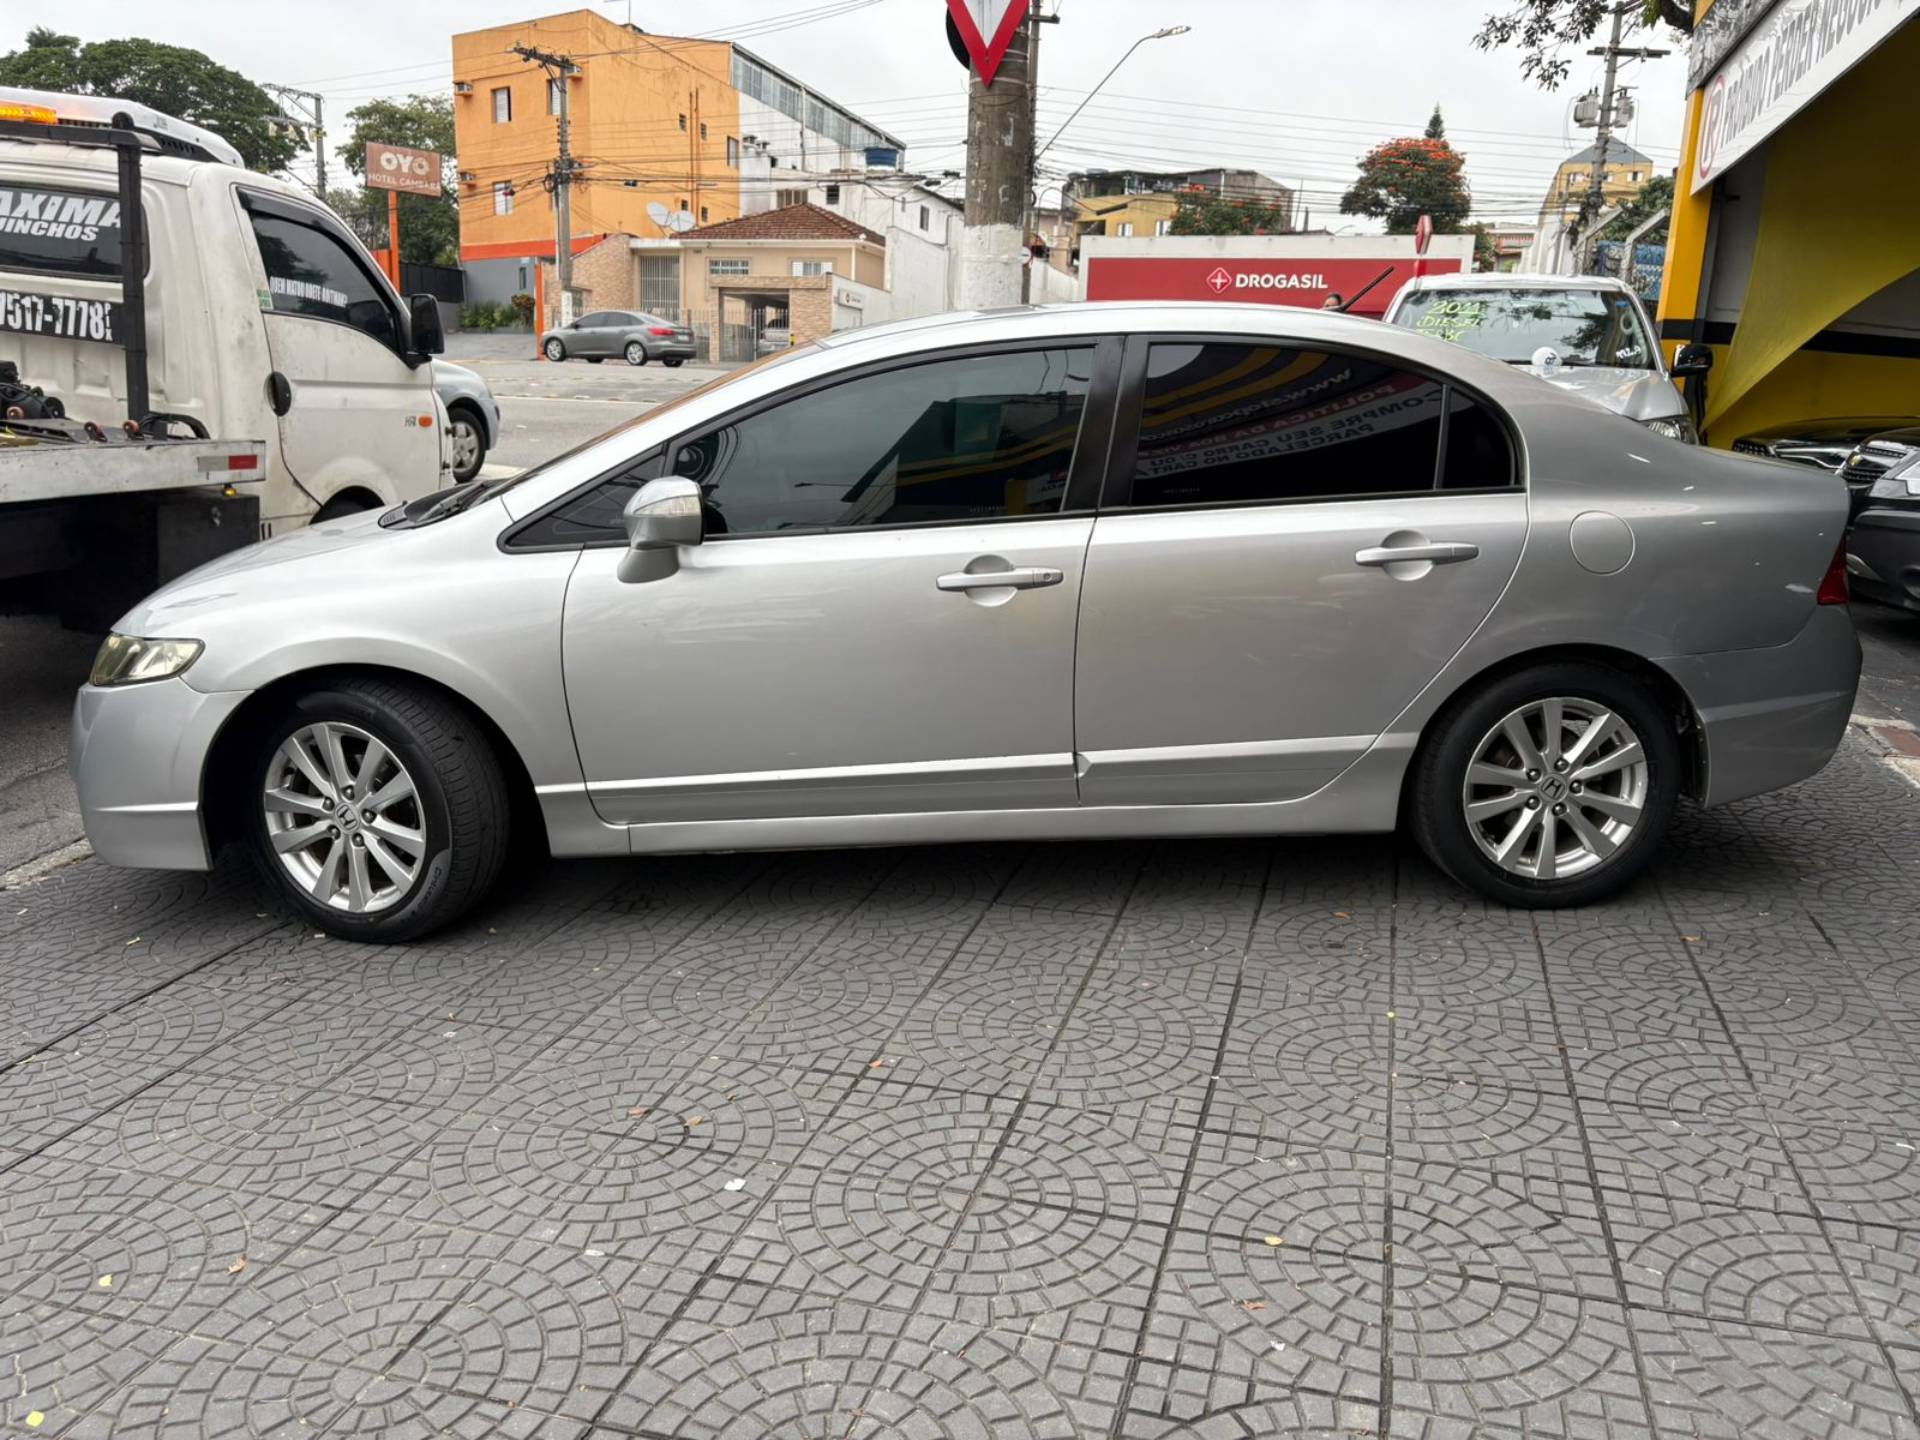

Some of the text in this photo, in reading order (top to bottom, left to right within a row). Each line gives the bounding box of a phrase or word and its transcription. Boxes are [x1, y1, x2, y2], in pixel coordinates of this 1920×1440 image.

[380, 151, 430, 176] OYO
[367, 173, 398, 186] HOTEL
[1235, 273, 1329, 289] DROGASIL
